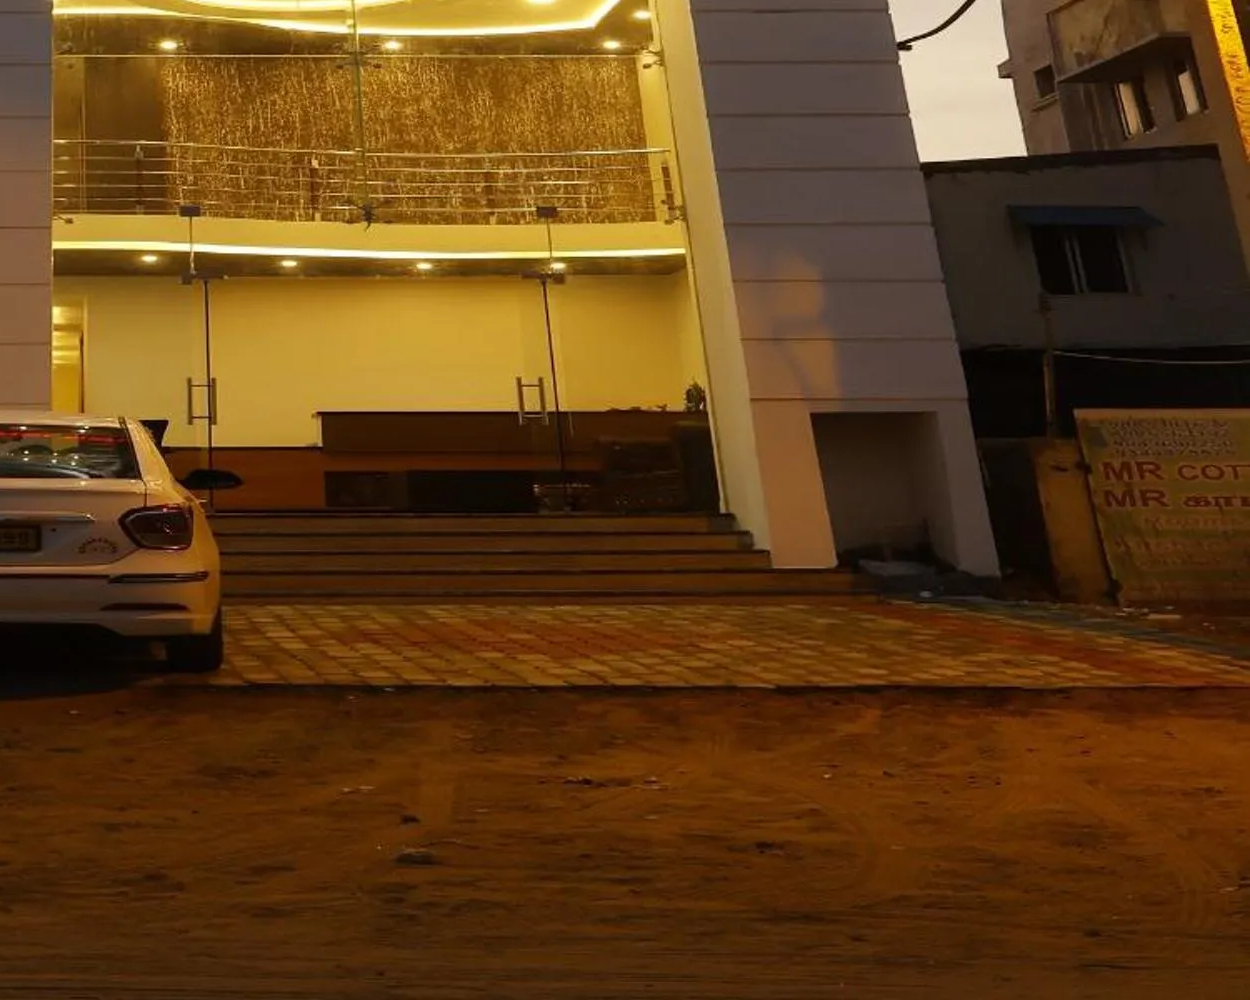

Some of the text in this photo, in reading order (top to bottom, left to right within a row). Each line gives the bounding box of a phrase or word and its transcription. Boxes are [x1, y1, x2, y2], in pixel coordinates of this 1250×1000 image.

[1103, 460, 1250, 481] MR COT
[1104, 488, 1171, 508] MR
